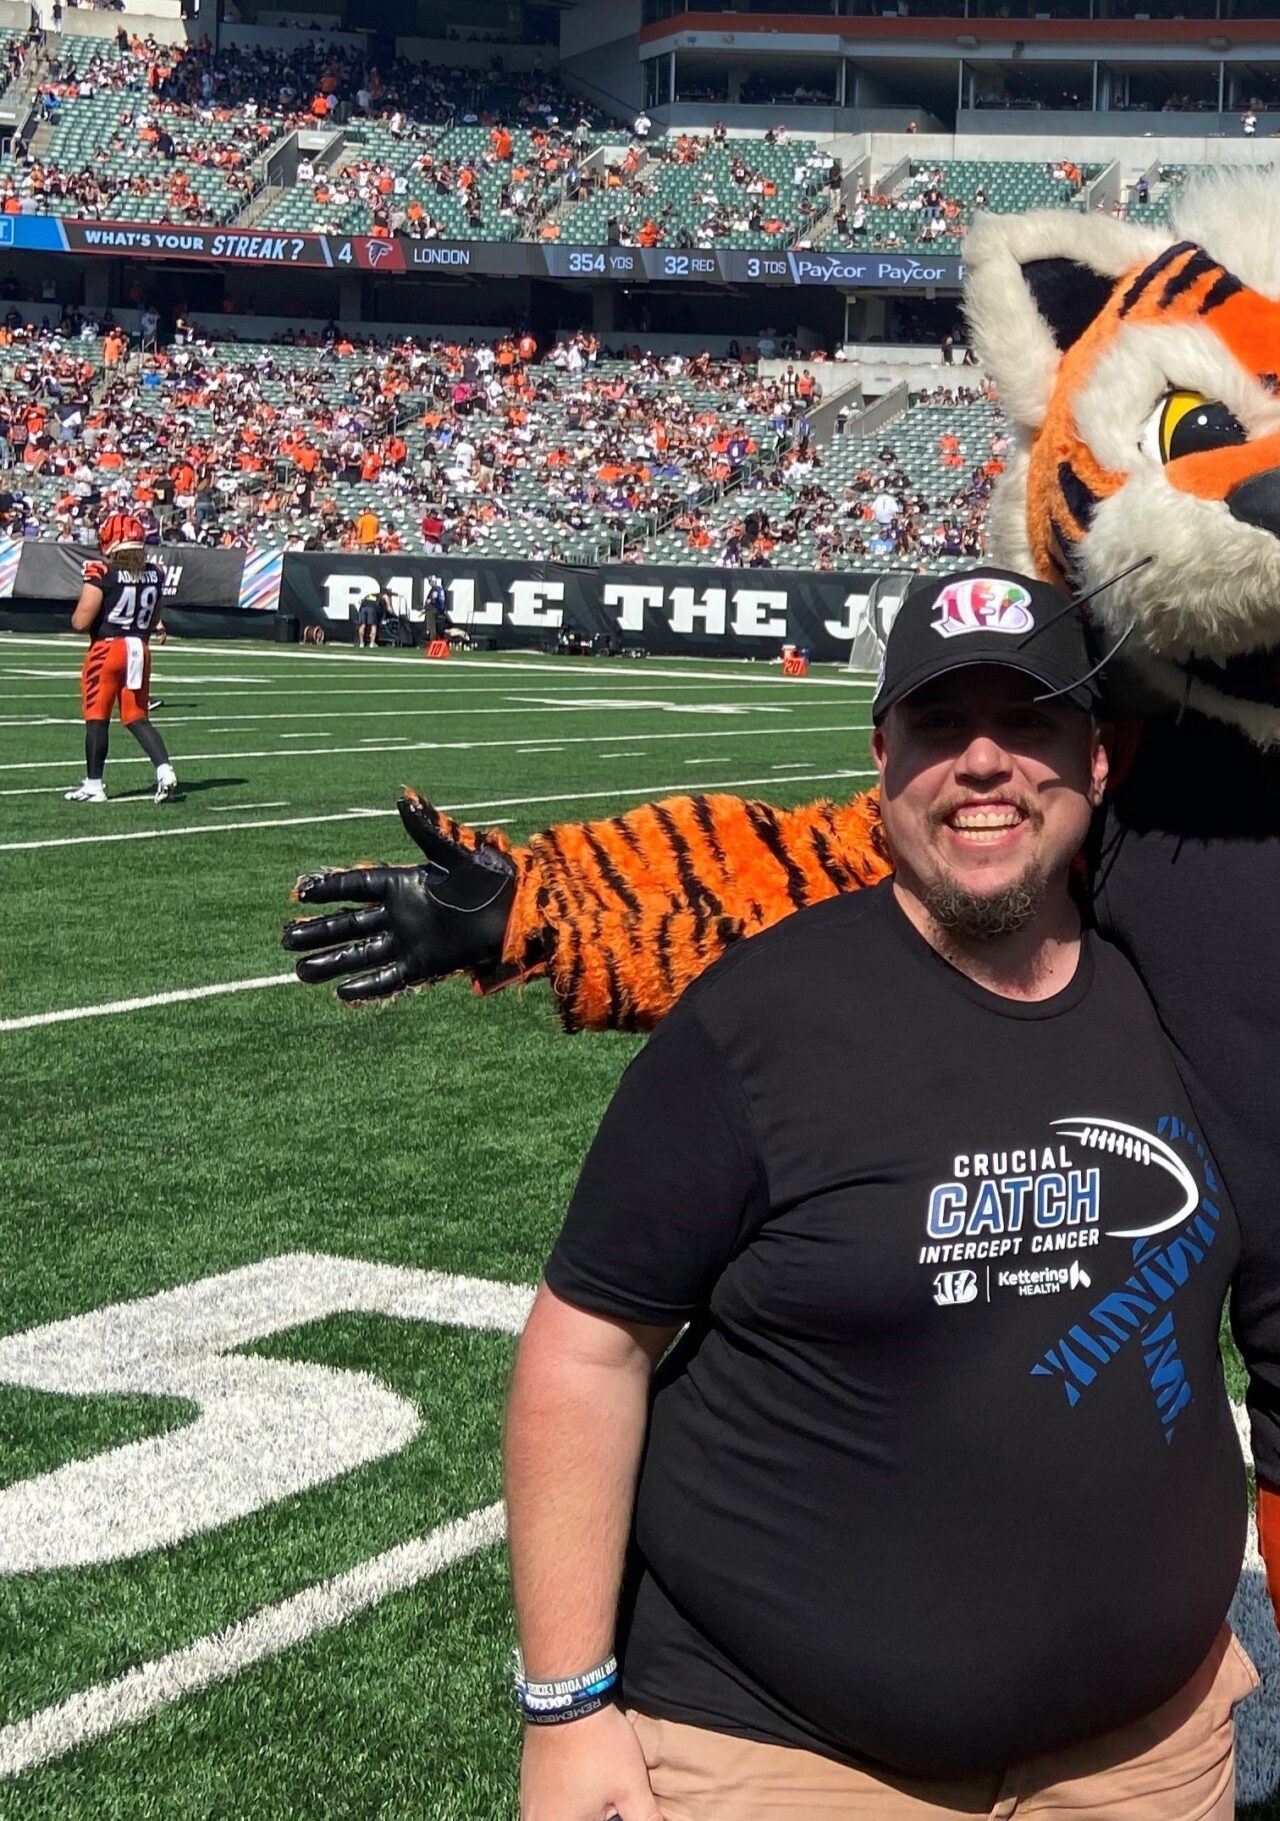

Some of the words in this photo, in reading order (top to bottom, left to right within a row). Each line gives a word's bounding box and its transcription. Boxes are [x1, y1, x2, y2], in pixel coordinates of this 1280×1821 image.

[85, 230, 151, 246] WHAT'S
[155, 237, 204, 250] YOUR
[338, 243, 352, 263] 4
[414, 248, 470, 265] LONDON
[569, 253, 605, 272] 354
[610, 256, 634, 269] YDS
[664, 256, 689, 274] 32
[692, 259, 714, 271] REC
[748, 258, 760, 277] 3
[763, 261, 787, 275] TDS
[799, 260, 866, 281] Paycor
[878, 262, 946, 283] Paycor
[108, 586, 157, 630] 48
[322, 574, 564, 628] RULE
[604, 584, 787, 637] THE
[430, 642, 443, 657] 10
[785, 659, 800, 674] 20
[954, 1145, 1072, 1178] CRUCIAL
[926, 1167, 1100, 1239] CATCH
[918, 1237, 1023, 1265] INTERCEPT
[1031, 1228, 1100, 1253] CANCER
[998, 1267, 1069, 1286] Kettering
[1019, 1282, 1060, 1296] HEALTH
[555, 1677, 581, 1695] YOUR
